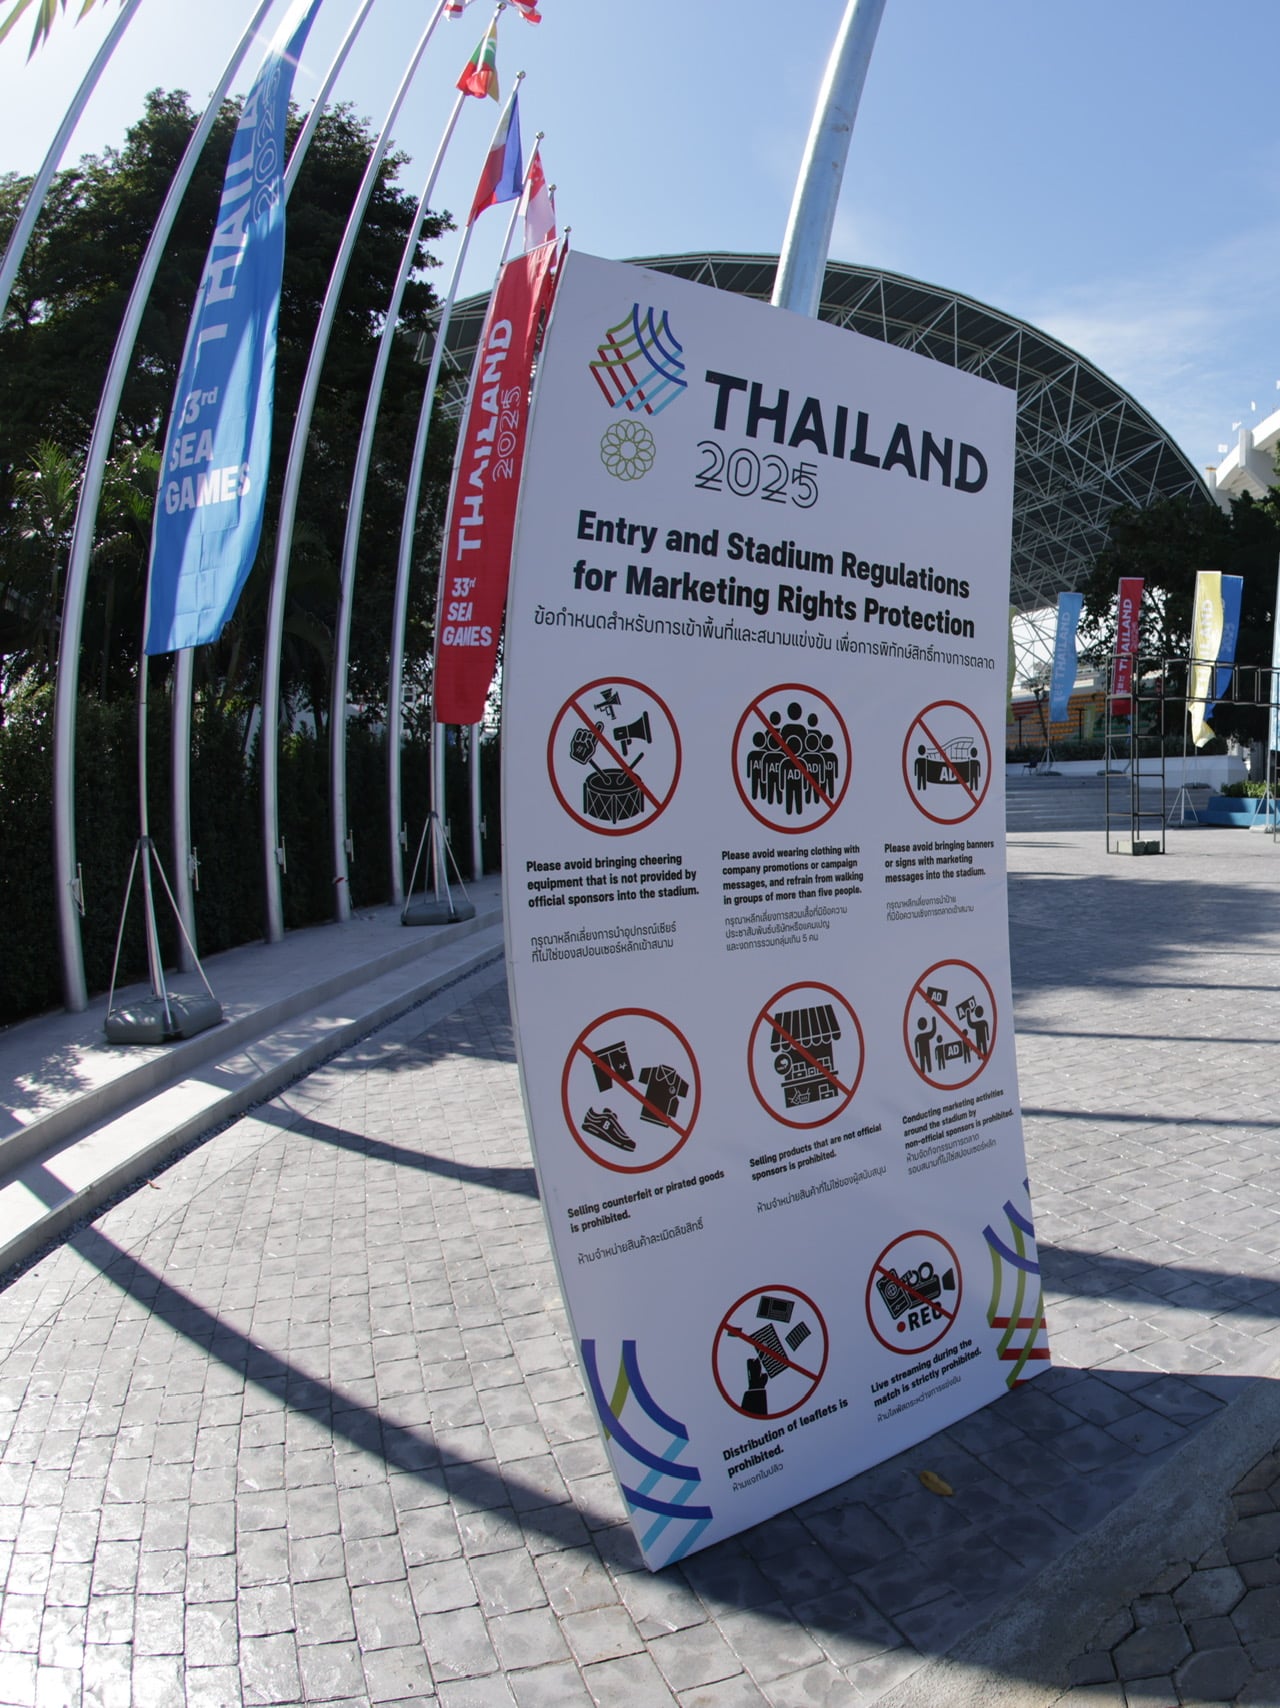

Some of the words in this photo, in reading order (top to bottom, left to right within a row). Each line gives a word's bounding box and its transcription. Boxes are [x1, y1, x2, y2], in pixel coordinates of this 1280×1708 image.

[457, 318, 512, 561] THAILAND
[493, 386, 521, 482] 2025
[704, 369, 989, 494] THAILAND
[169, 428, 213, 472] SEA
[165, 462, 250, 514] GAMES
[694, 440, 820, 509] 2025
[577, 509, 659, 554] Entry
[665, 528, 720, 558] and
[726, 531, 834, 576] Stadium
[841, 551, 970, 599] Regulations
[573, 559, 617, 593] for
[625, 564, 771, 616] Marketing
[777, 583, 857, 622] Rights
[863, 597, 975, 639] Protection
[534, 604, 833, 651] ข้อกำหนดสำหรับการเข้าพื้นที่และสนามแข่งขัน
[835, 631, 996, 671] เพื่อการพิทักษ์สิทธิ์ทางการตลาด
[787, 769, 800, 780] AD
[526, 860, 562, 872] Please
[564, 858, 592, 870] avoid
[595, 856, 637, 870] bringing
[639, 853, 682, 866] cheering
[722, 851, 750, 860] Please
[752, 848, 775, 858] avoid
[777, 848, 808, 858] wearing
[810, 846, 842, 856] clothing
[844, 844, 860, 854] with
[884, 843, 910, 853] Please
[912, 842, 933, 852] avoid
[935, 841, 965, 851] bringing
[966, 840, 994, 848] banners
[884, 860, 893, 868] or
[895, 858, 916, 869] signs
[918, 856, 934, 866] with
[936, 854, 973, 864] marketing
[527, 876, 583, 892] equipment
[586, 874, 607, 886] that
[609, 873, 618, 884] is
[621, 872, 637, 884] not
[640, 869, 683, 885] provided
[684, 869, 697, 881] by
[722, 864, 761, 875] company
[763, 862, 808, 874] promotions
[821, 858, 858, 870] campaign
[723, 879, 768, 890] messages,
[769, 878, 784, 886] and
[786, 875, 813, 886] refrain
[815, 874, 833, 883] from
[835, 872, 864, 882] walking
[885, 872, 924, 883] messages
[925, 870, 940, 880] into
[942, 869, 954, 878] the
[956, 868, 986, 878] stadium.
[528, 894, 565, 908] official
[568, 892, 614, 906] sponsors
[617, 889, 637, 901] into
[639, 888, 656, 899] the
[658, 885, 700, 898] stadium.
[723, 895, 732, 905] in
[734, 895, 763, 906] groups
[765, 892, 774, 901] of
[776, 891, 796, 900] more
[798, 890, 816, 898] than
[818, 888, 832, 897] five
[835, 886, 862, 896] people.
[802, 934, 808, 942] 5
[931, 991, 942, 1002] AD
[948, 1045, 960, 1057] AD
[902, 1107, 942, 1124] Conducting
[942, 1097, 975, 1113] marketing
[976, 1088, 1004, 1103] activities
[904, 1123, 928, 1137] around
[929, 1120, 940, 1129] the
[942, 1113, 968, 1126] stadium
[969, 1109, 977, 1118] by
[905, 1130, 945, 1150] non-official
[946, 1123, 974, 1138] sponsors
[975, 1119, 981, 1127] is
[982, 1108, 1014, 1127] prohibited.
[749, 1154, 777, 1168] Selling
[778, 1144, 812, 1160] products
[813, 1138, 829, 1150] that
[830, 1135, 842, 1145] are
[843, 1130, 856, 1141] not
[857, 1123, 882, 1138] official
[751, 1164, 788, 1182] sponsors
[789, 1161, 796, 1170] is
[797, 1149, 837, 1170] prohibited.
[567, 1203, 600, 1219] Selling
[602, 1189, 652, 1210] counterfeit
[654, 1185, 664, 1196] or
[665, 1176, 697, 1195] pirated
[699, 1169, 725, 1185] goods
[570, 1223, 580, 1233] is
[581, 1209, 631, 1233] prohibited.
[870, 1379, 889, 1393] Live
[891, 1360, 932, 1385] streaming
[933, 1346, 958, 1364] during
[959, 1339, 972, 1350] the
[874, 1388, 901, 1407] match
[902, 1384, 910, 1393] is
[911, 1369, 939, 1389] strictly
[941, 1348, 982, 1375] prohibited.
[722, 1427, 785, 1461] Distribution
[787, 1419, 798, 1432] of
[800, 1403, 838, 1426] leaflets
[838, 1398, 848, 1409] is
[727, 1444, 784, 1478] prohibited.
